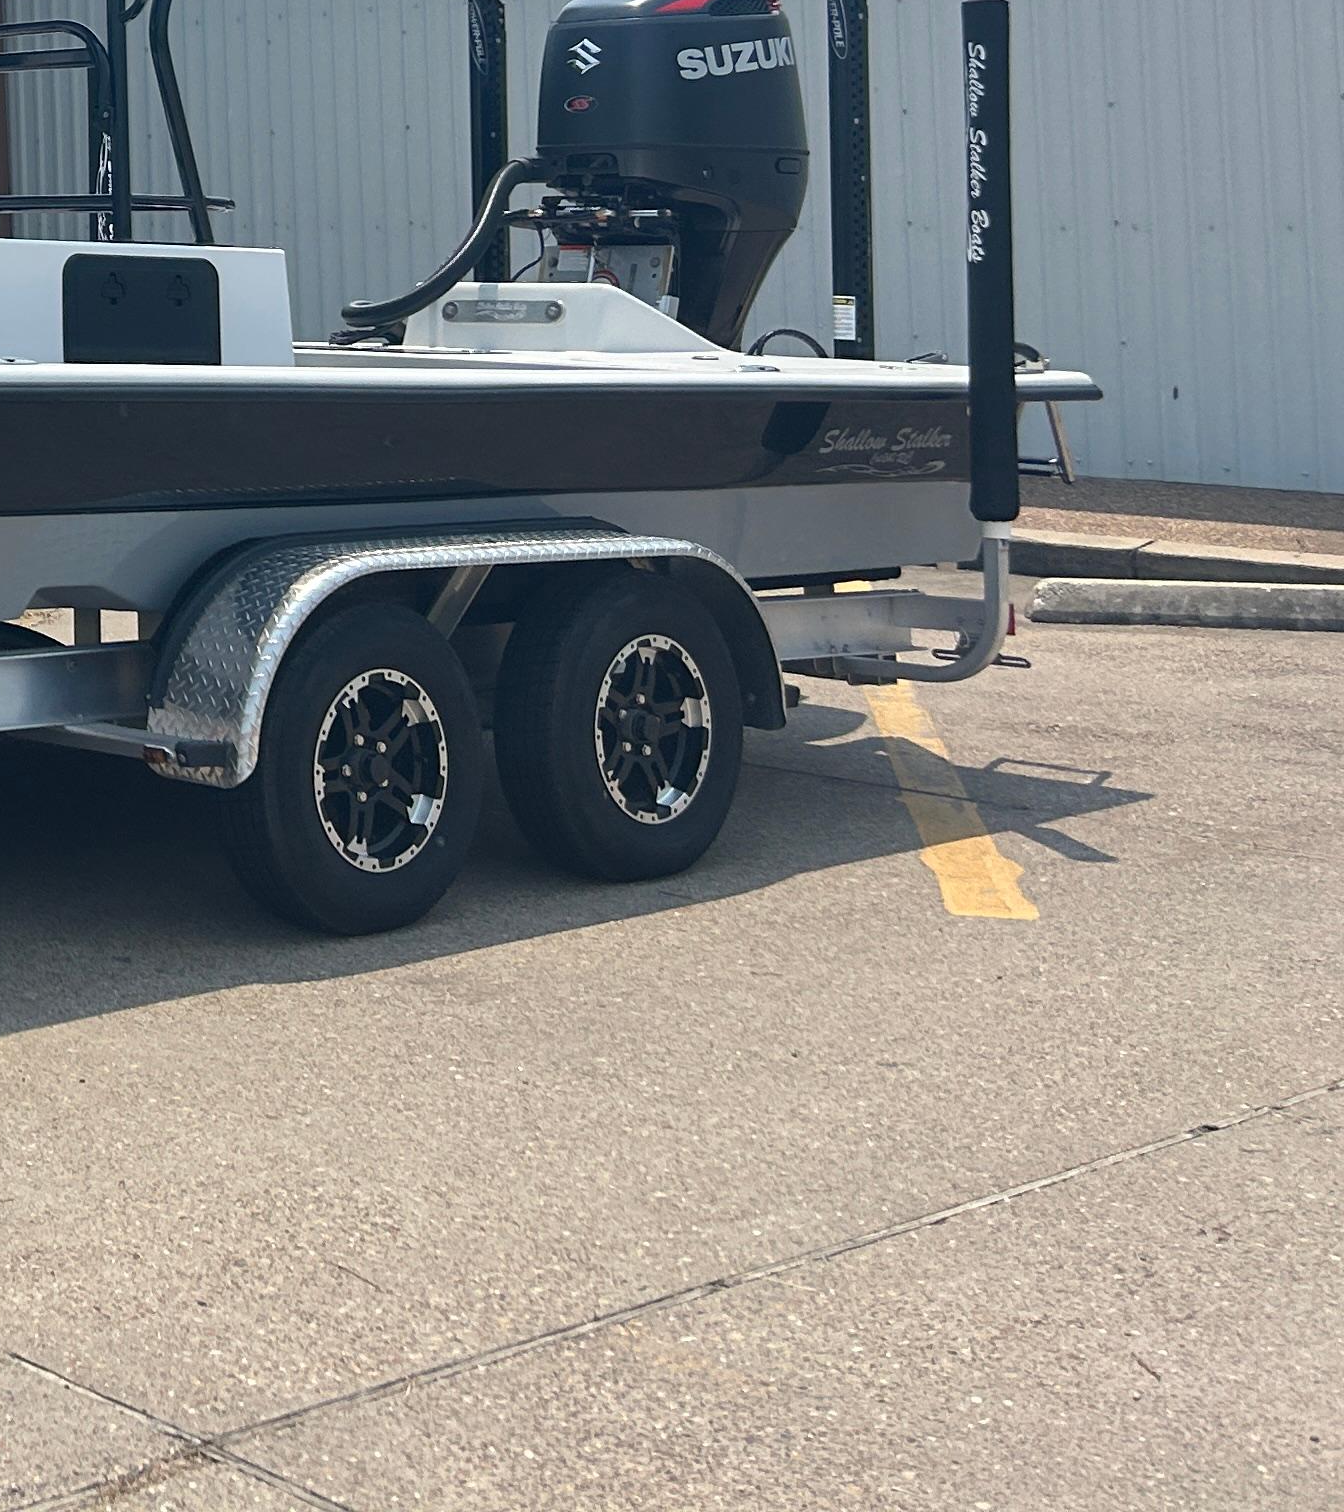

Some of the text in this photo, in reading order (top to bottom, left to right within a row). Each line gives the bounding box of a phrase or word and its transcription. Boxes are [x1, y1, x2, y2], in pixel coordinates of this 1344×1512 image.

[676, 36, 795, 80] SUZUKI
[967, 41, 990, 264] Shallow Stalker Boats
[819, 424, 953, 454] Shallow Stalker
